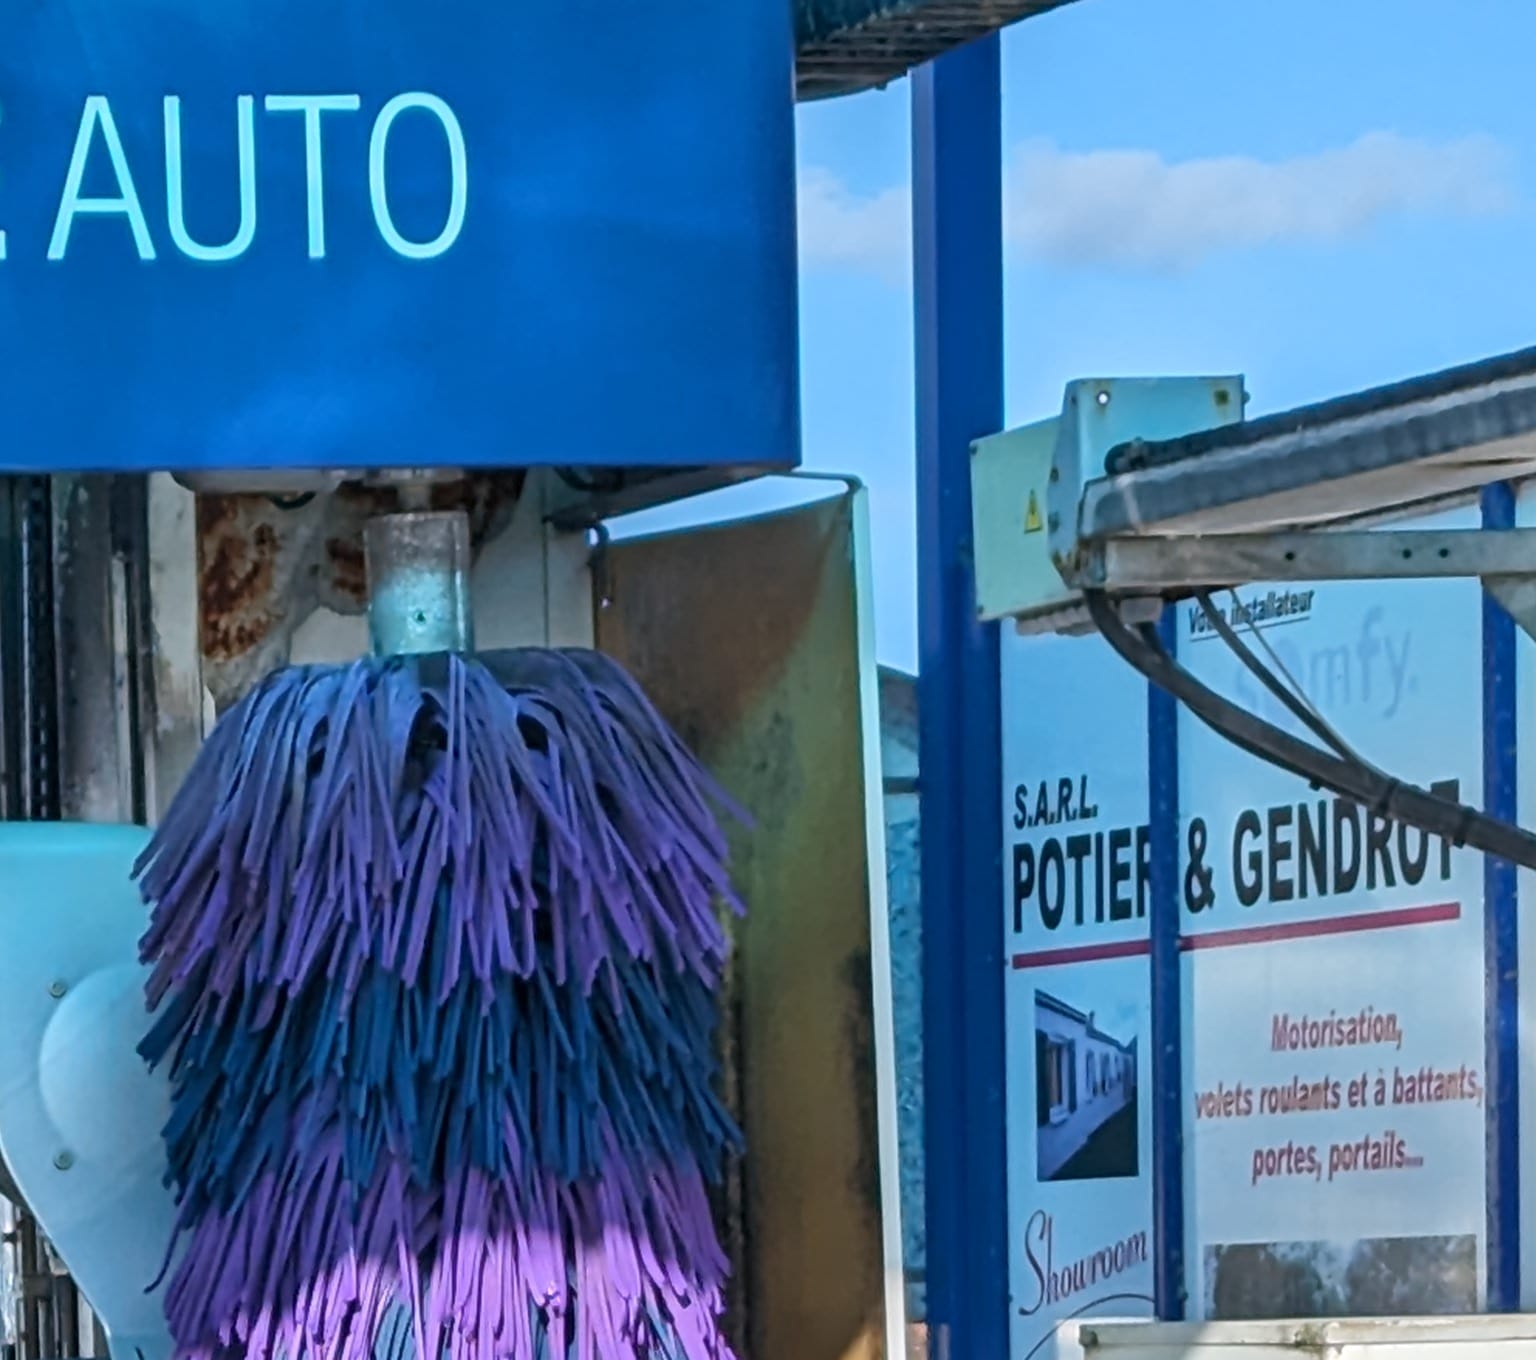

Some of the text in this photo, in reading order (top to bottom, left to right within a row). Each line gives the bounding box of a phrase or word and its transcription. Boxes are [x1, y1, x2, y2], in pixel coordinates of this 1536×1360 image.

[47, 91, 469, 261] AUTO
[1014, 774, 1098, 830] S.A.R.L.
[1183, 816, 1216, 914] &
[1271, 1005, 1403, 1051] Motorisation,
[1194, 1064, 1483, 1119] volets roulants et à battants,
[1251, 1140, 1322, 1186] portes,
[1018, 1209, 1147, 1316] Showroom
